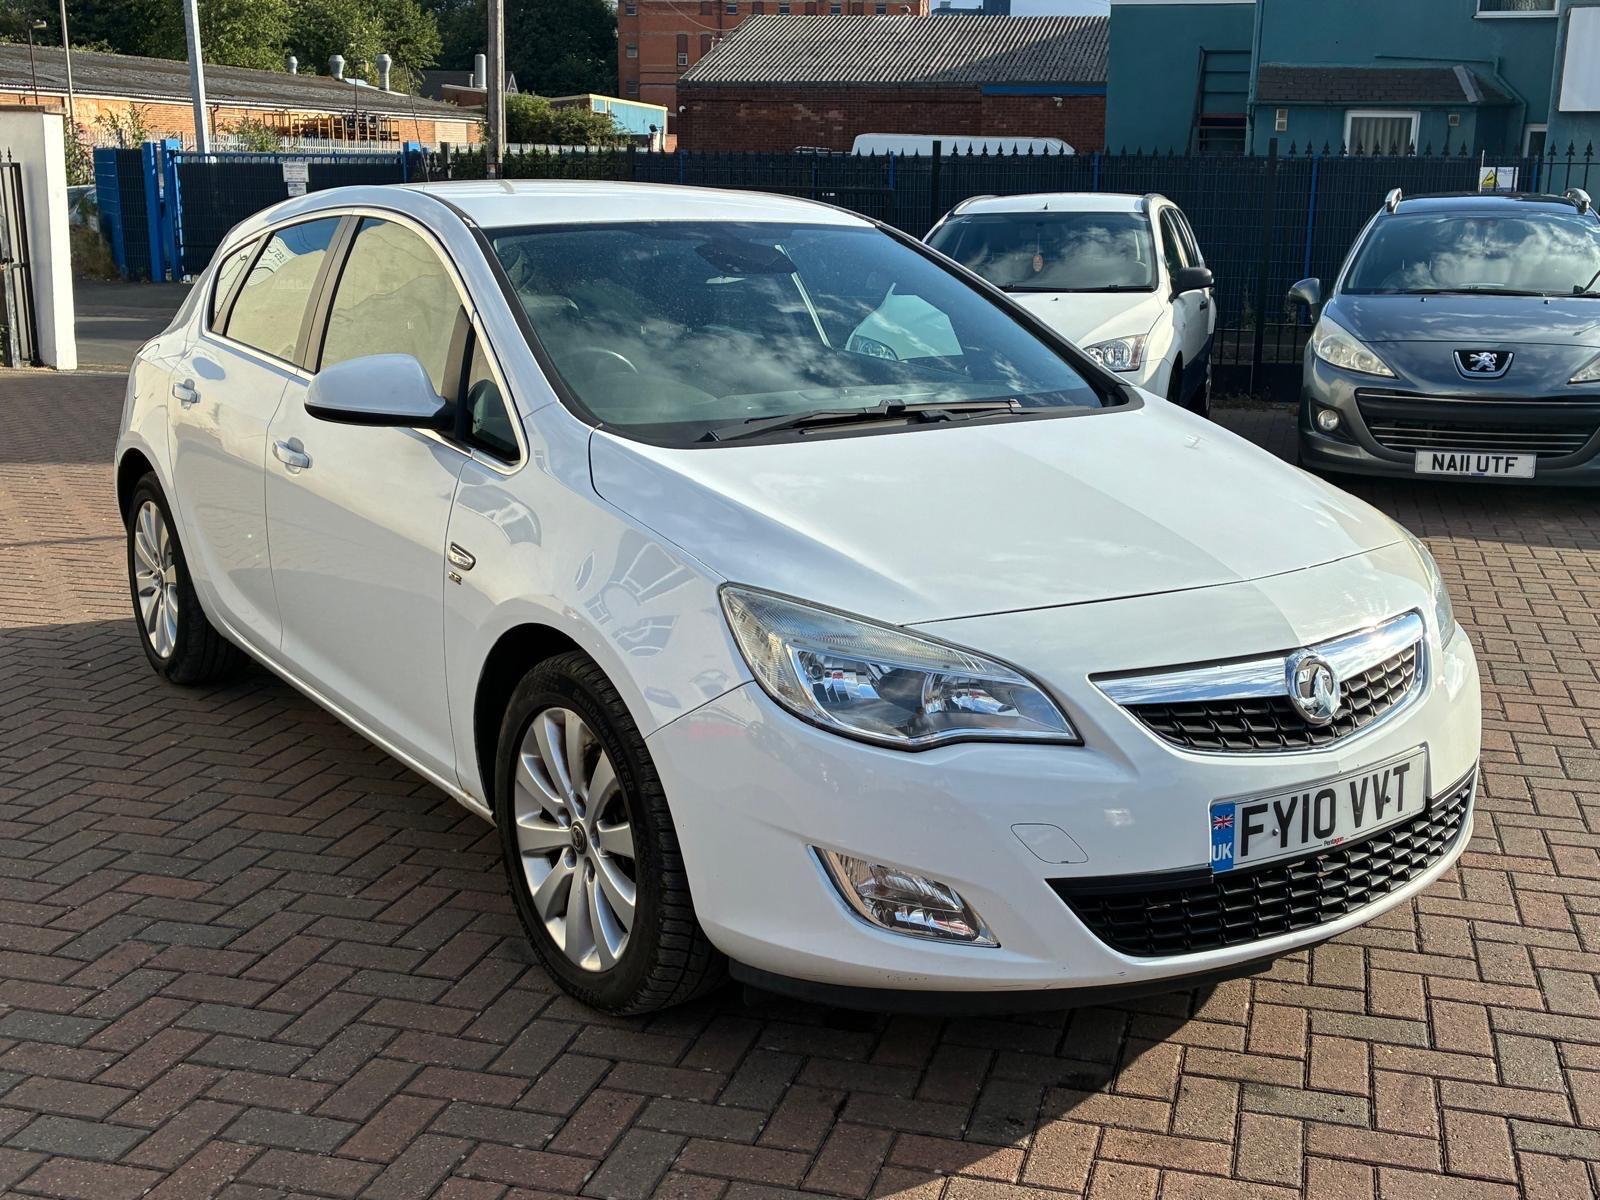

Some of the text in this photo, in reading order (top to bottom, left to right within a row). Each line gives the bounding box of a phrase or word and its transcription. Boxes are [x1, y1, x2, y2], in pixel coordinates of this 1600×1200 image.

[1432, 453, 1518, 474] NA11 UTF
[1240, 762, 1410, 857] FY10 VVT
[1212, 842, 1233, 861] UK
